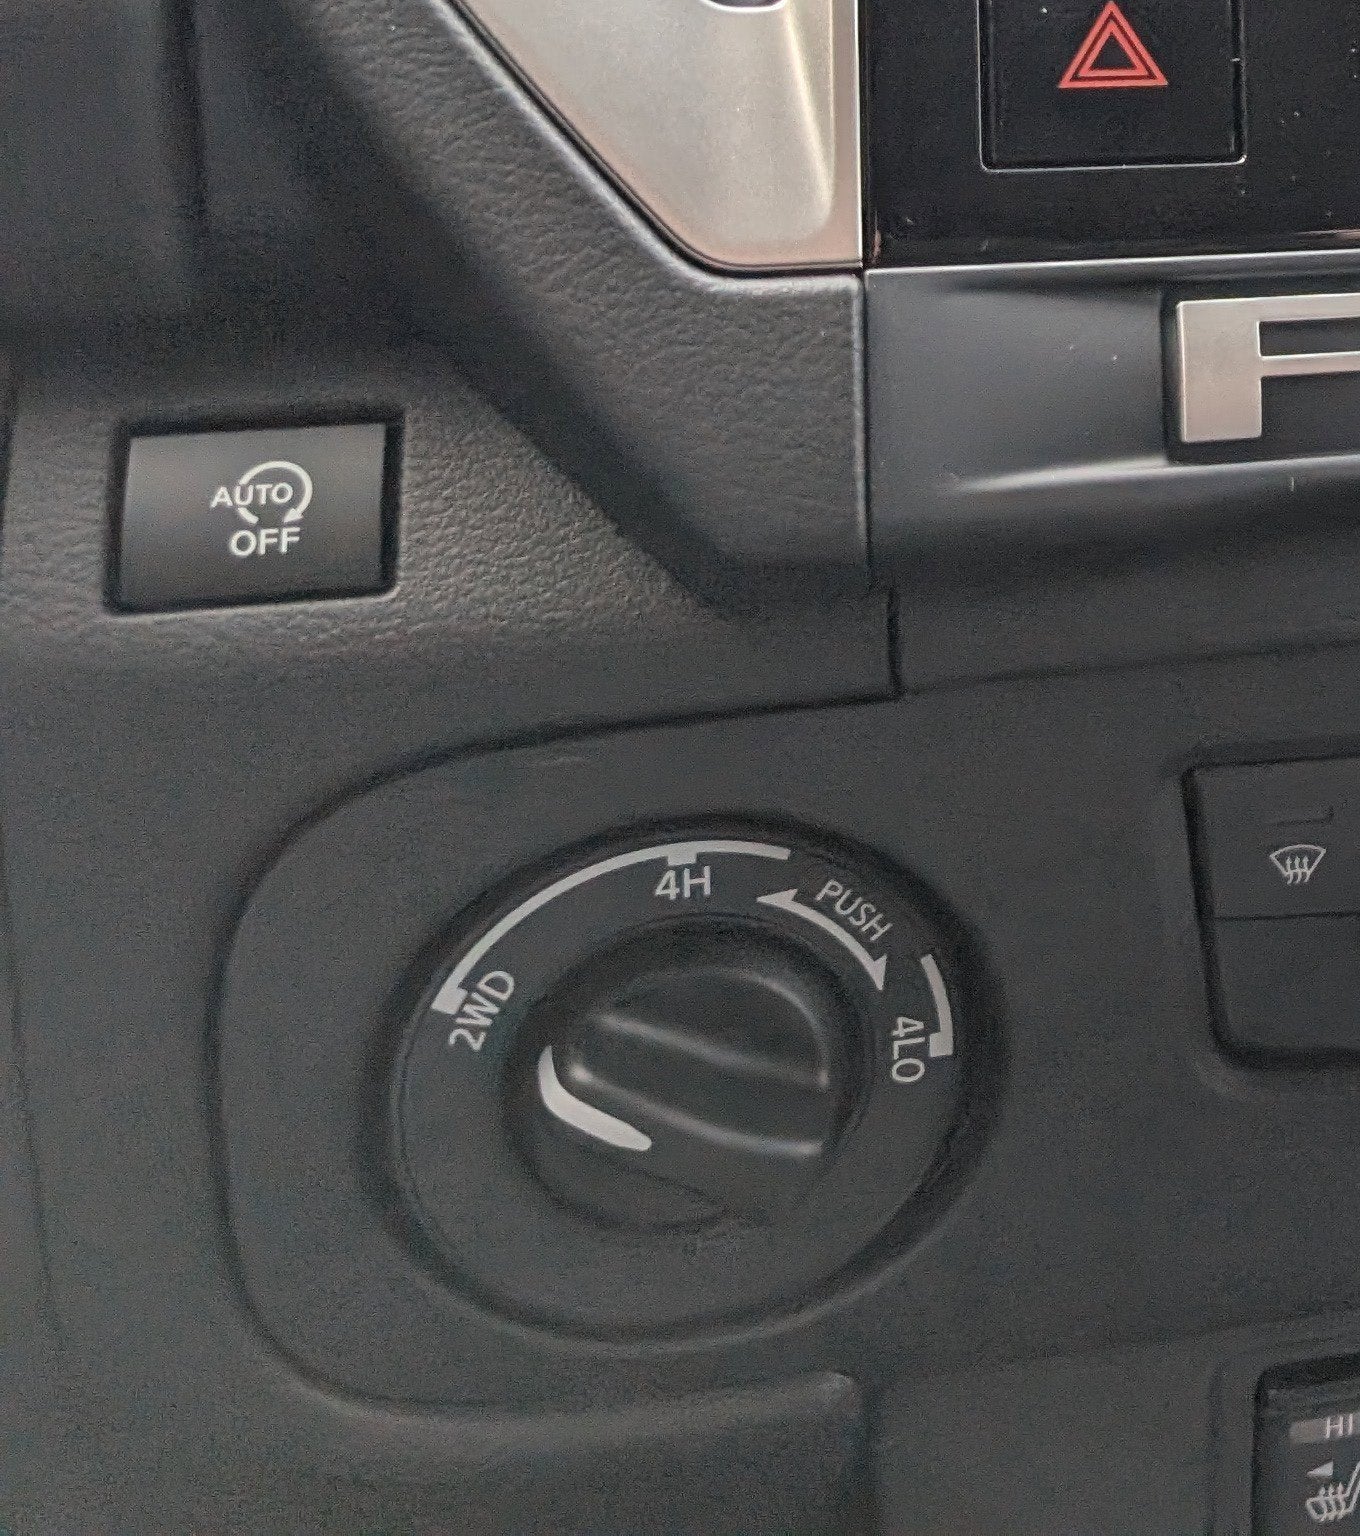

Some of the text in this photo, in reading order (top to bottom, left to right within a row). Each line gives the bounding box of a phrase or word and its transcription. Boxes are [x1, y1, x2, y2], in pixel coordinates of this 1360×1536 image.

[210, 482, 293, 509] AUTO
[229, 527, 300, 557] OFF
[653, 866, 711, 900] 4H
[815, 880, 892, 943] PUSH
[448, 969, 515, 1051] 2WD
[890, 1016, 925, 1083] 4LO
[1326, 1413, 1354, 1437] HI
